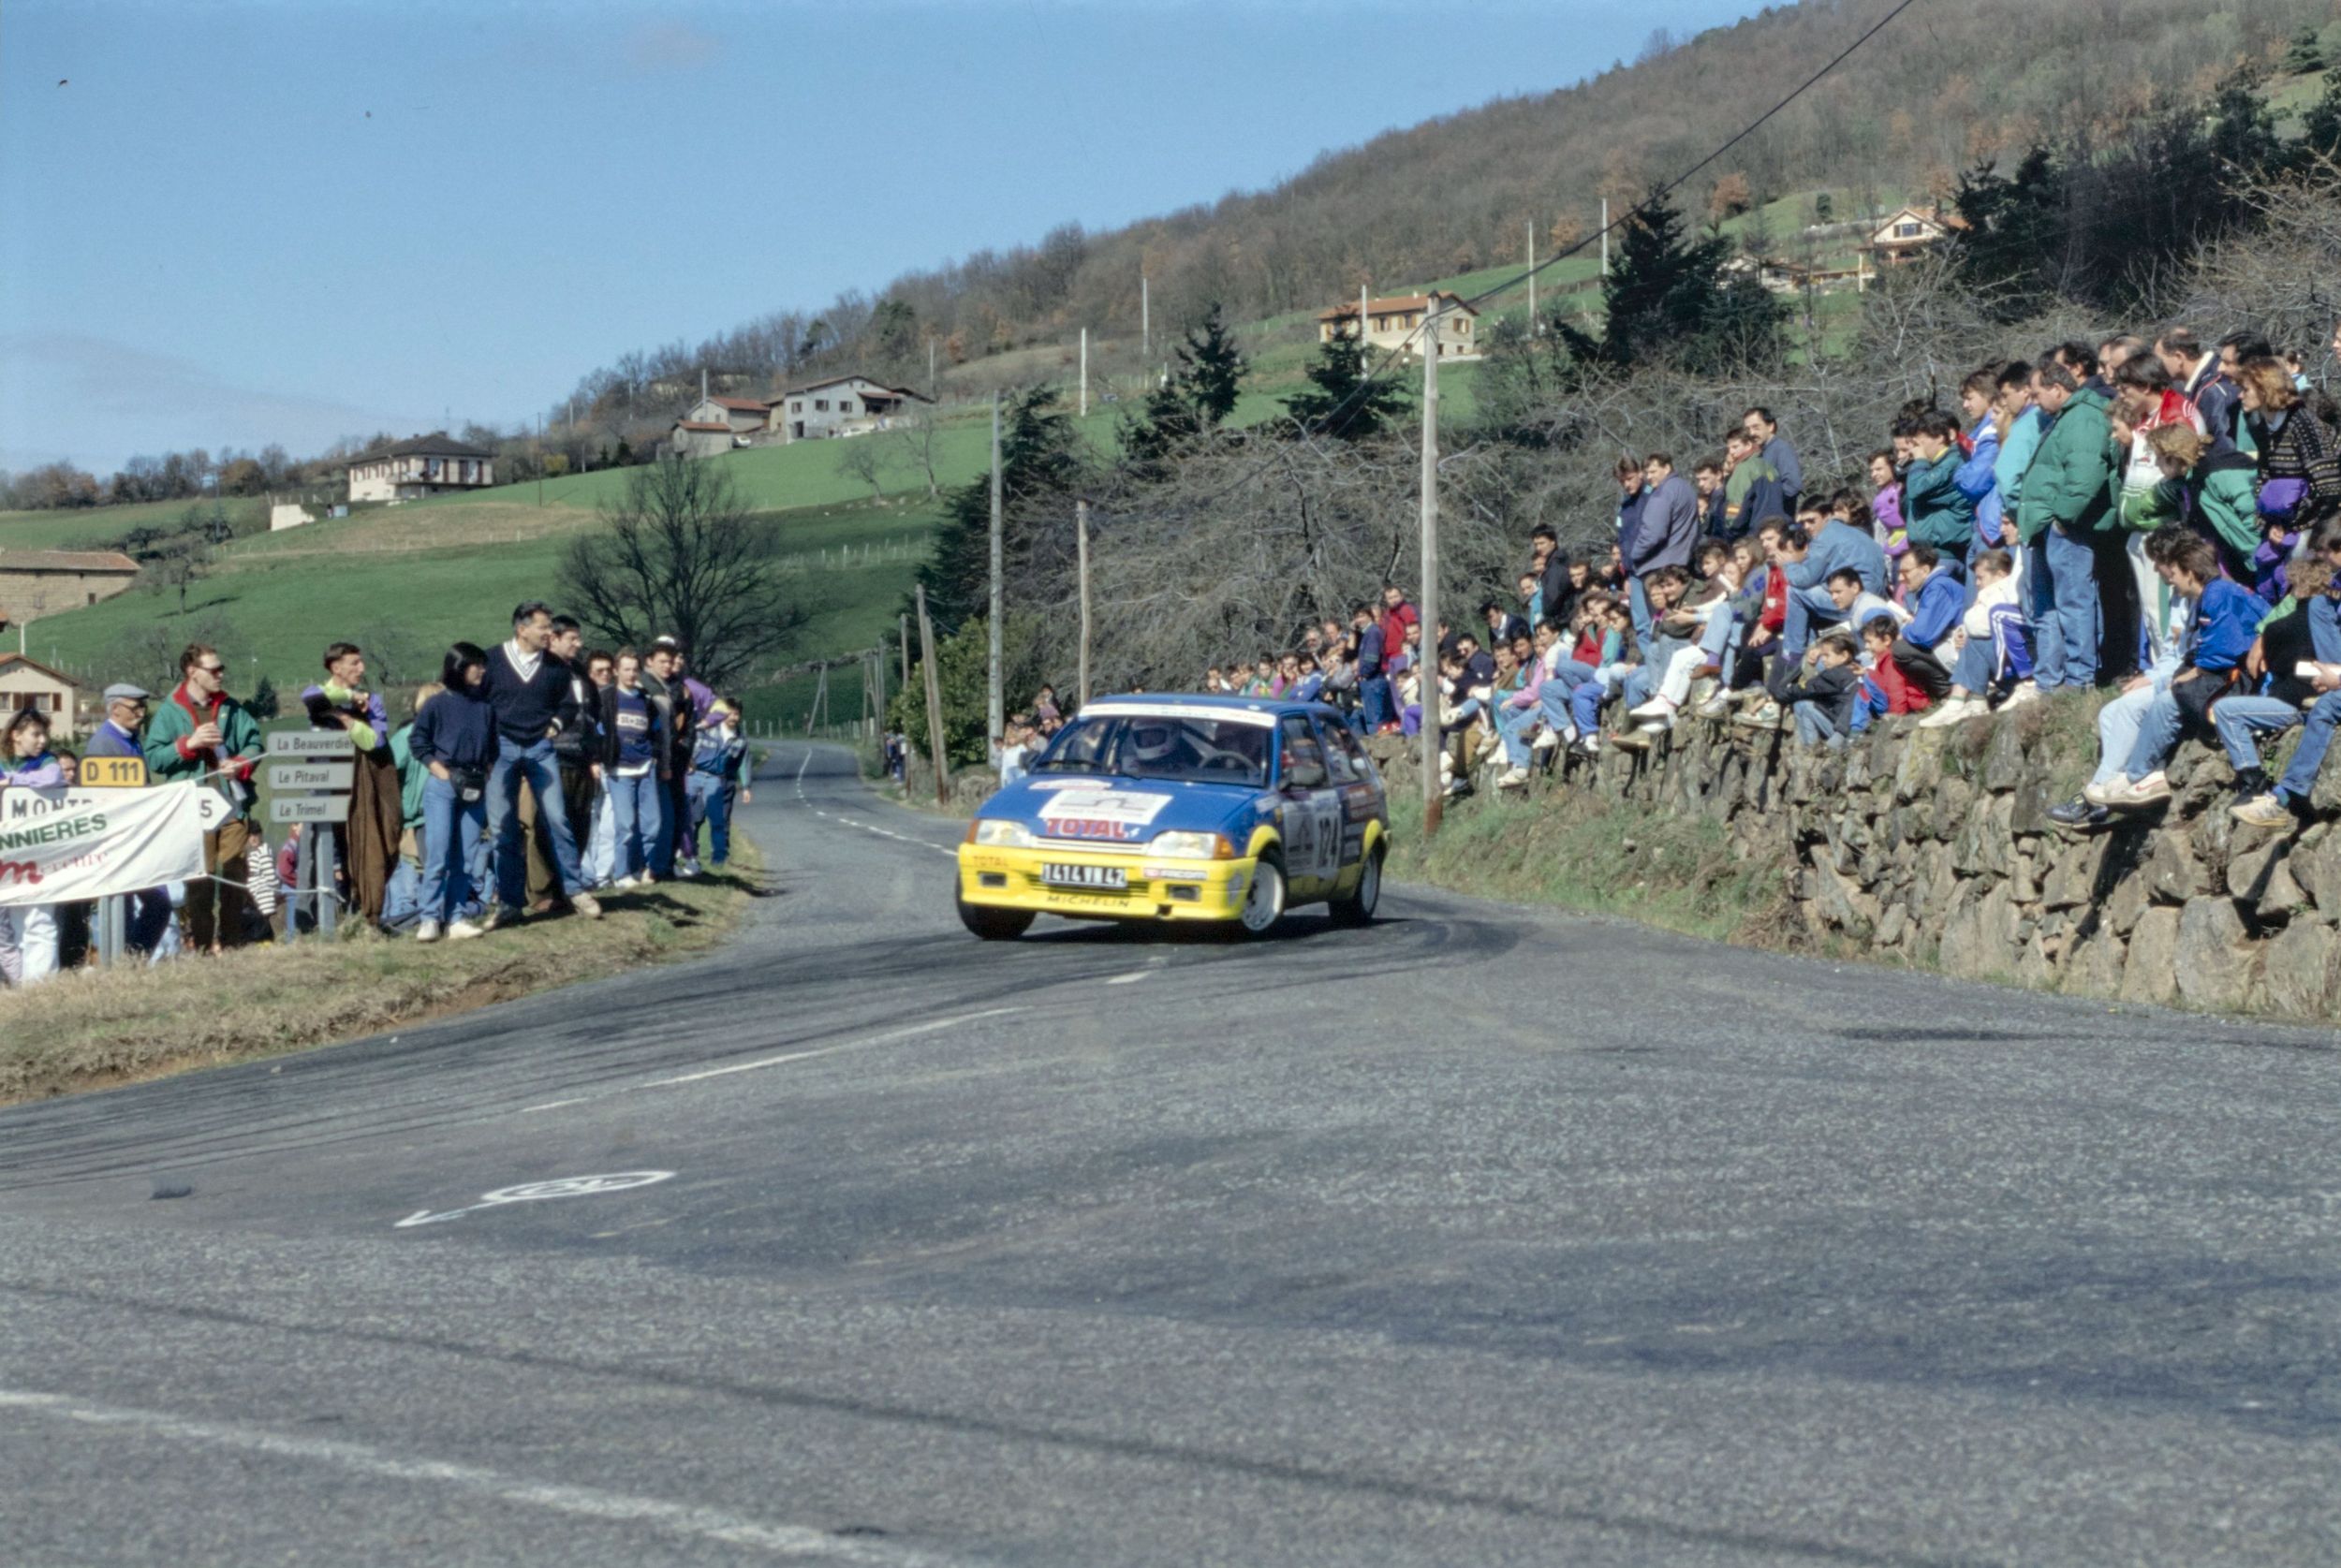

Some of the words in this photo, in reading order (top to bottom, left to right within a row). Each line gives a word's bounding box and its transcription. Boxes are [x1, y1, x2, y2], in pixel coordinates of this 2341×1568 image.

[277, 739, 289, 750] La
[86, 761, 99, 782] D
[108, 761, 140, 782] 111
[279, 771, 290, 784] Le
[295, 770, 330, 784] Pitaval
[280, 804, 291, 817] Le
[296, 804, 326, 816] Trimel
[1046, 817, 1128, 839] TOTAL
[1046, 895, 1130, 908] MICHELIN
